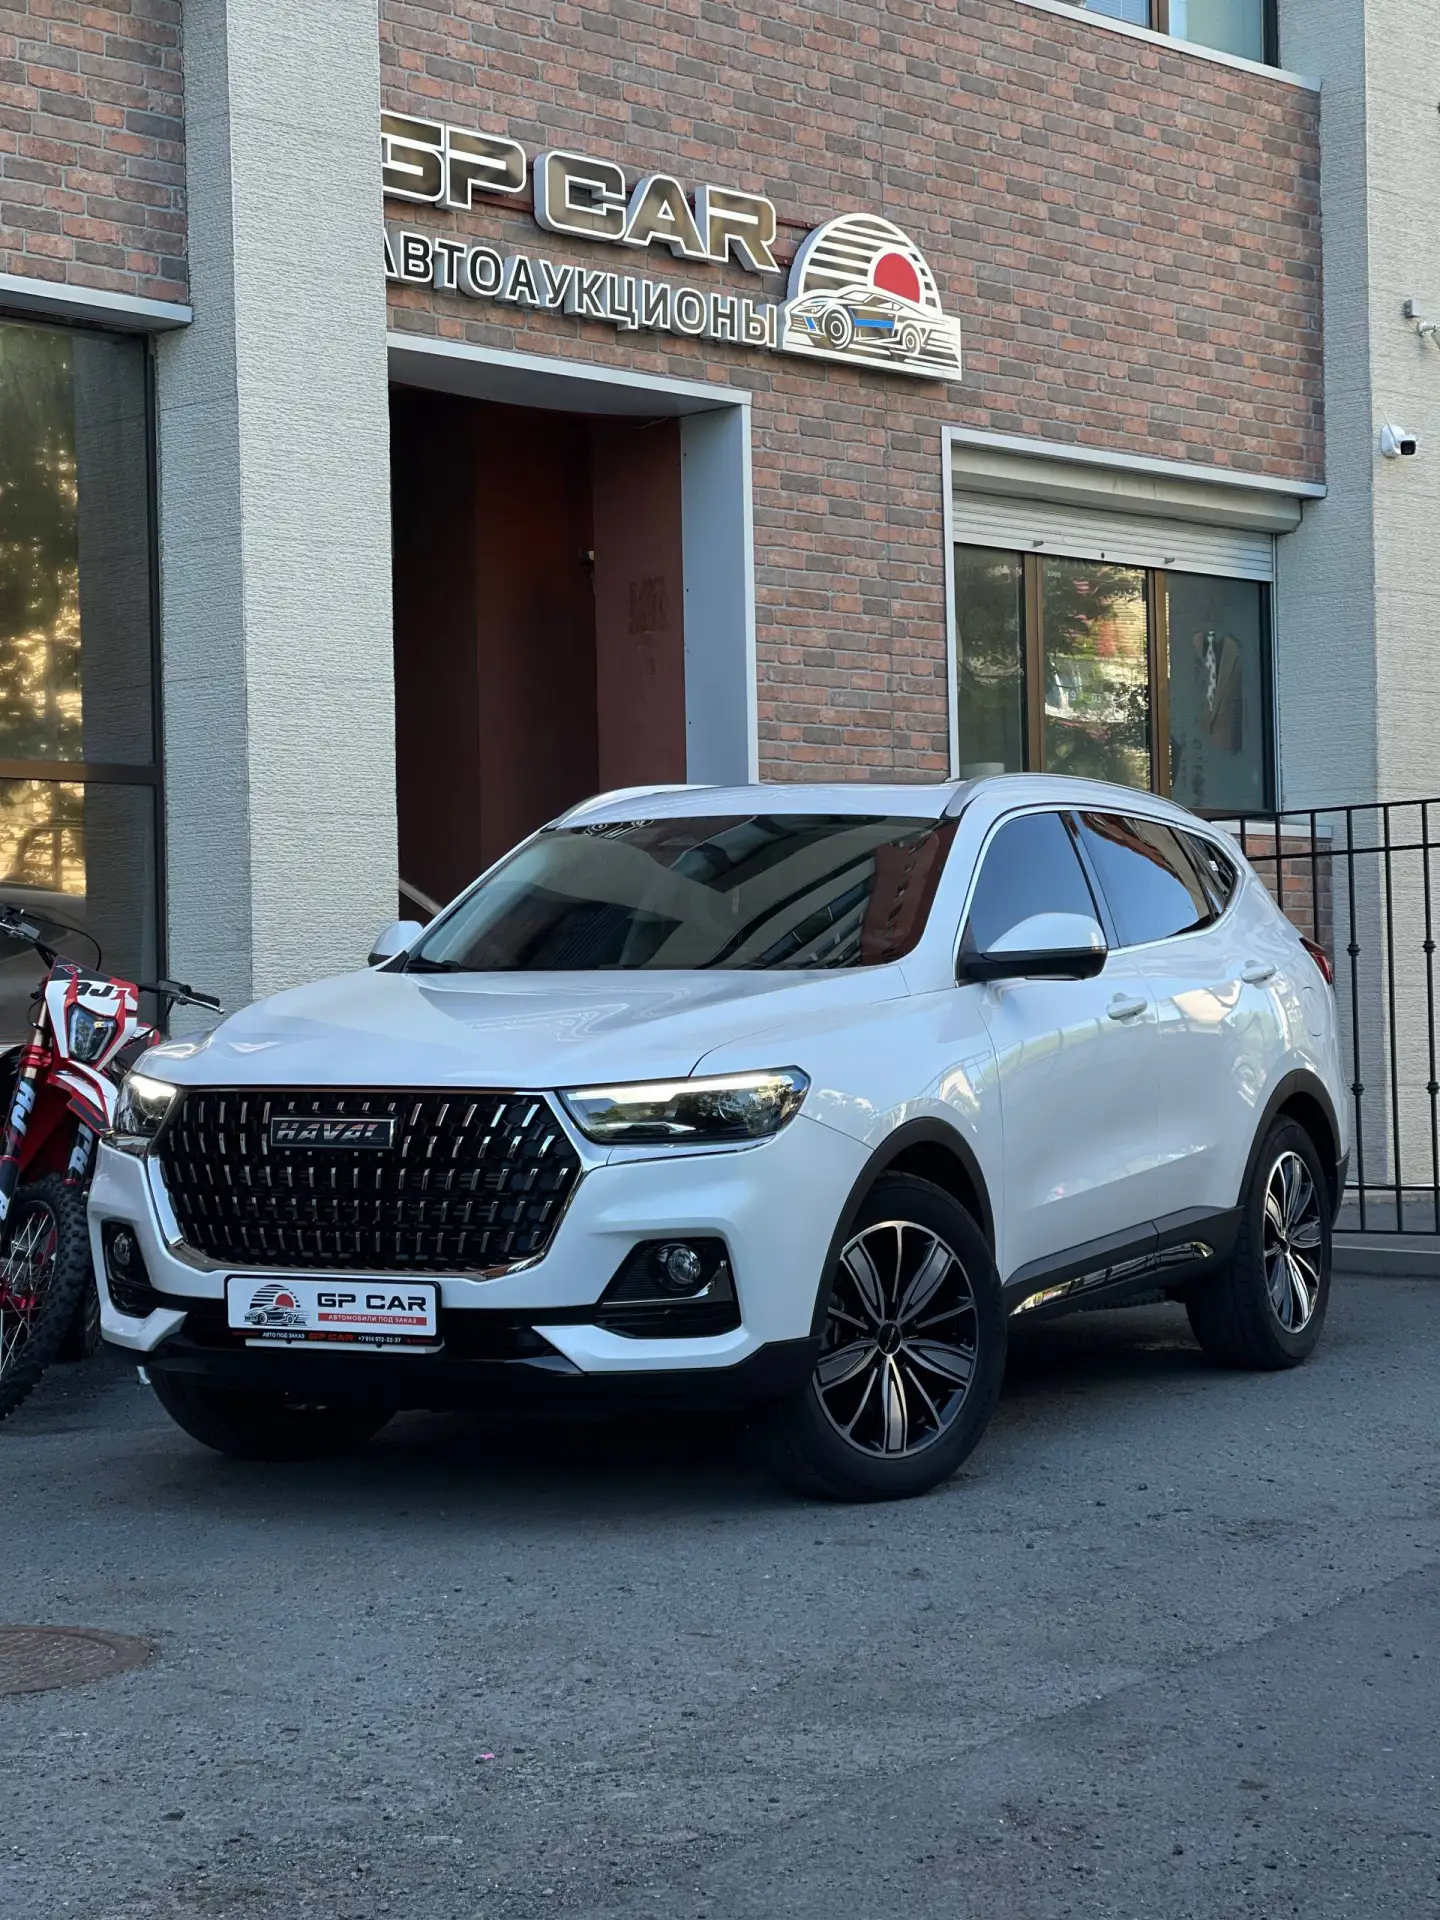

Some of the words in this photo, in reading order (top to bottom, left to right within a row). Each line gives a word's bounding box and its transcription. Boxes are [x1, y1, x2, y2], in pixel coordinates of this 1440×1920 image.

[380, 108, 526, 211] GP
[538, 149, 781, 273] CAR
[276, 1122, 385, 1143] HAVAL
[317, 1292, 356, 1309] GP
[366, 1294, 426, 1312] CAR
[328, 1314, 377, 1323] АВТОМОБИЛИ
[378, 1316, 394, 1325] ПОД
[309, 1332, 326, 1340] GP
[328, 1334, 355, 1342] CAR
